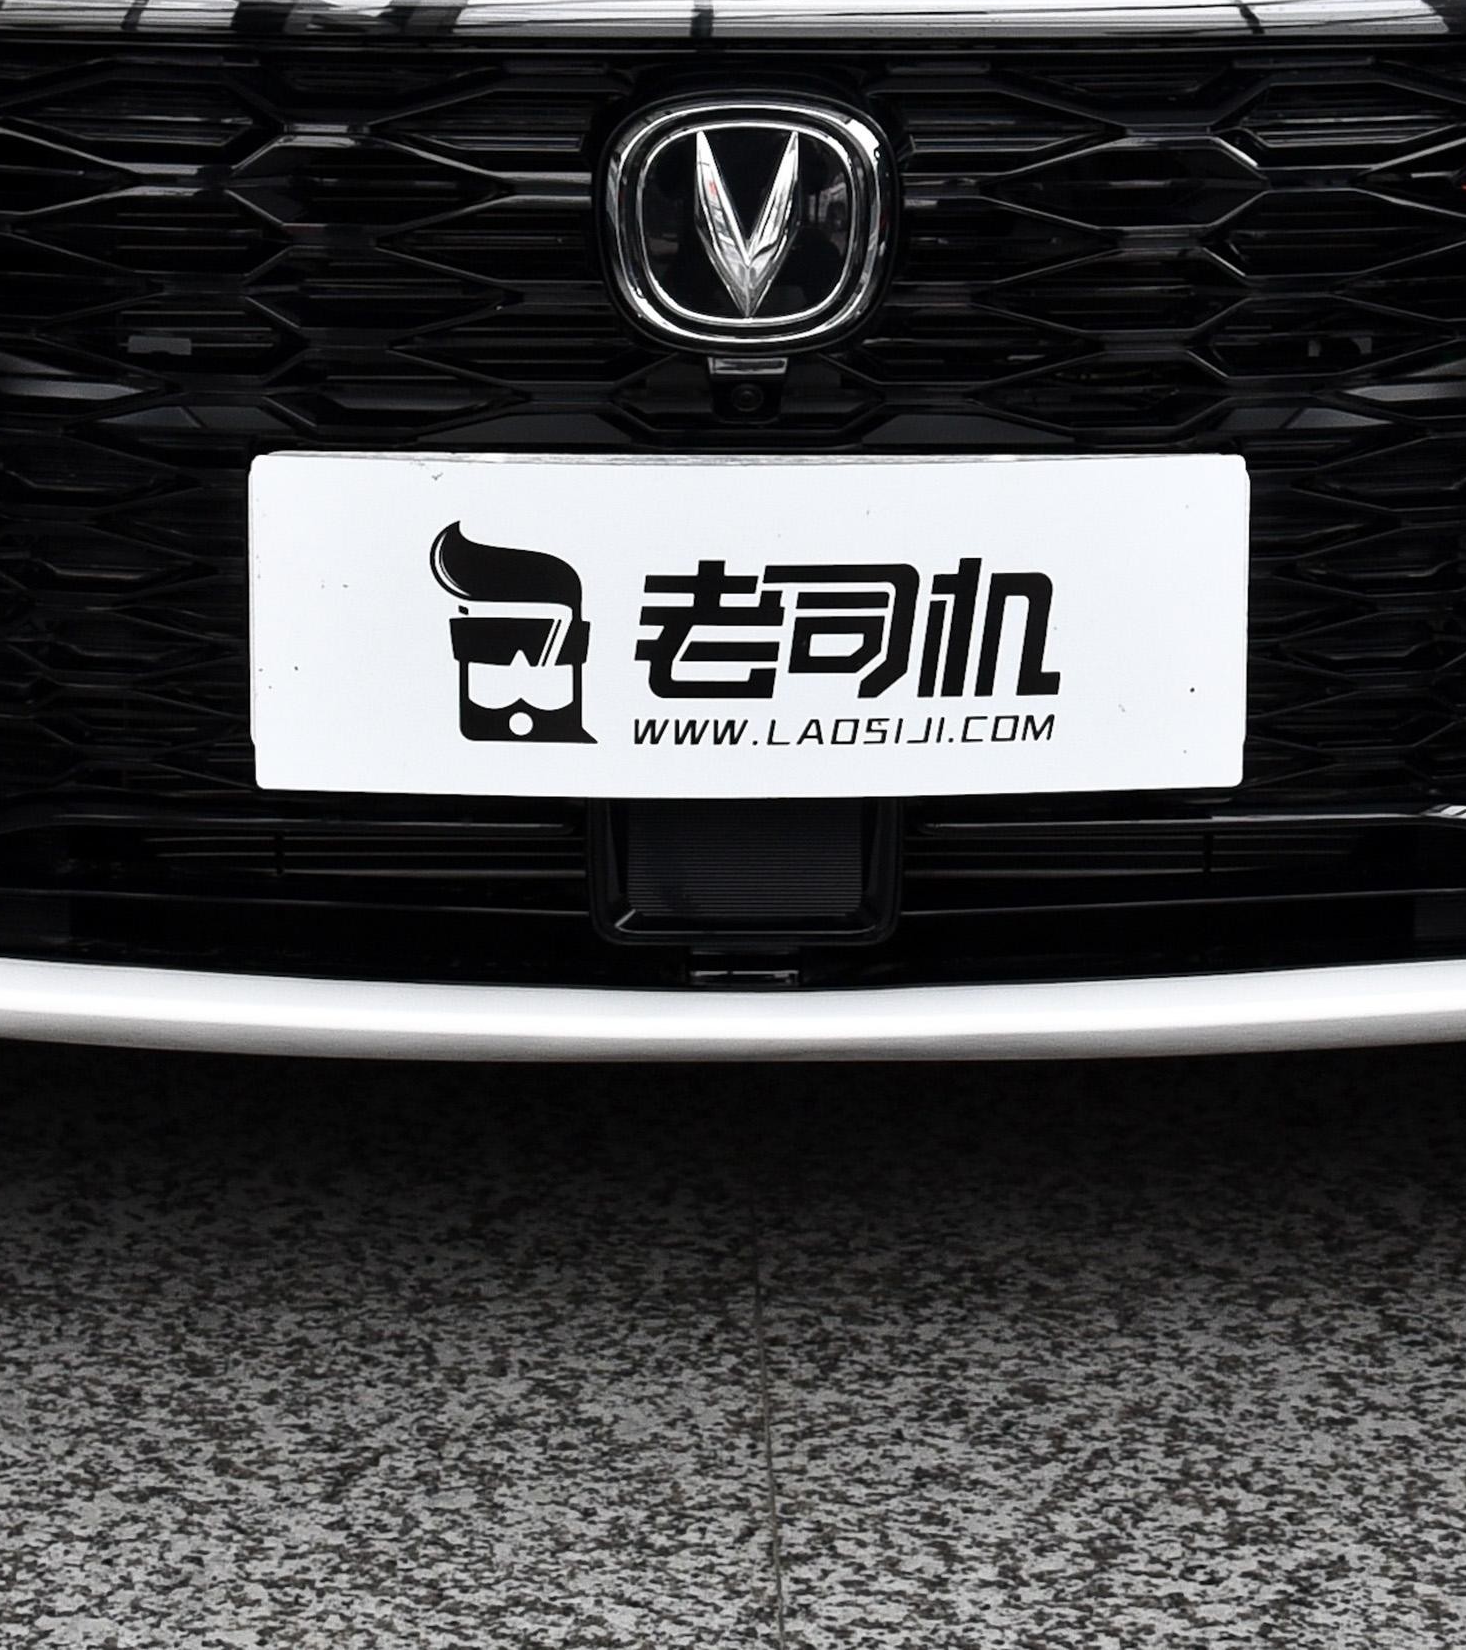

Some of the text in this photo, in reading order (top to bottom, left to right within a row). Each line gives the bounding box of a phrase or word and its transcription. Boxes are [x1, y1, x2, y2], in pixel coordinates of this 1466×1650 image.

[634, 557, 1061, 699] 老司机
[633, 713, 1056, 746] WWW.LAOSIJI.COM
